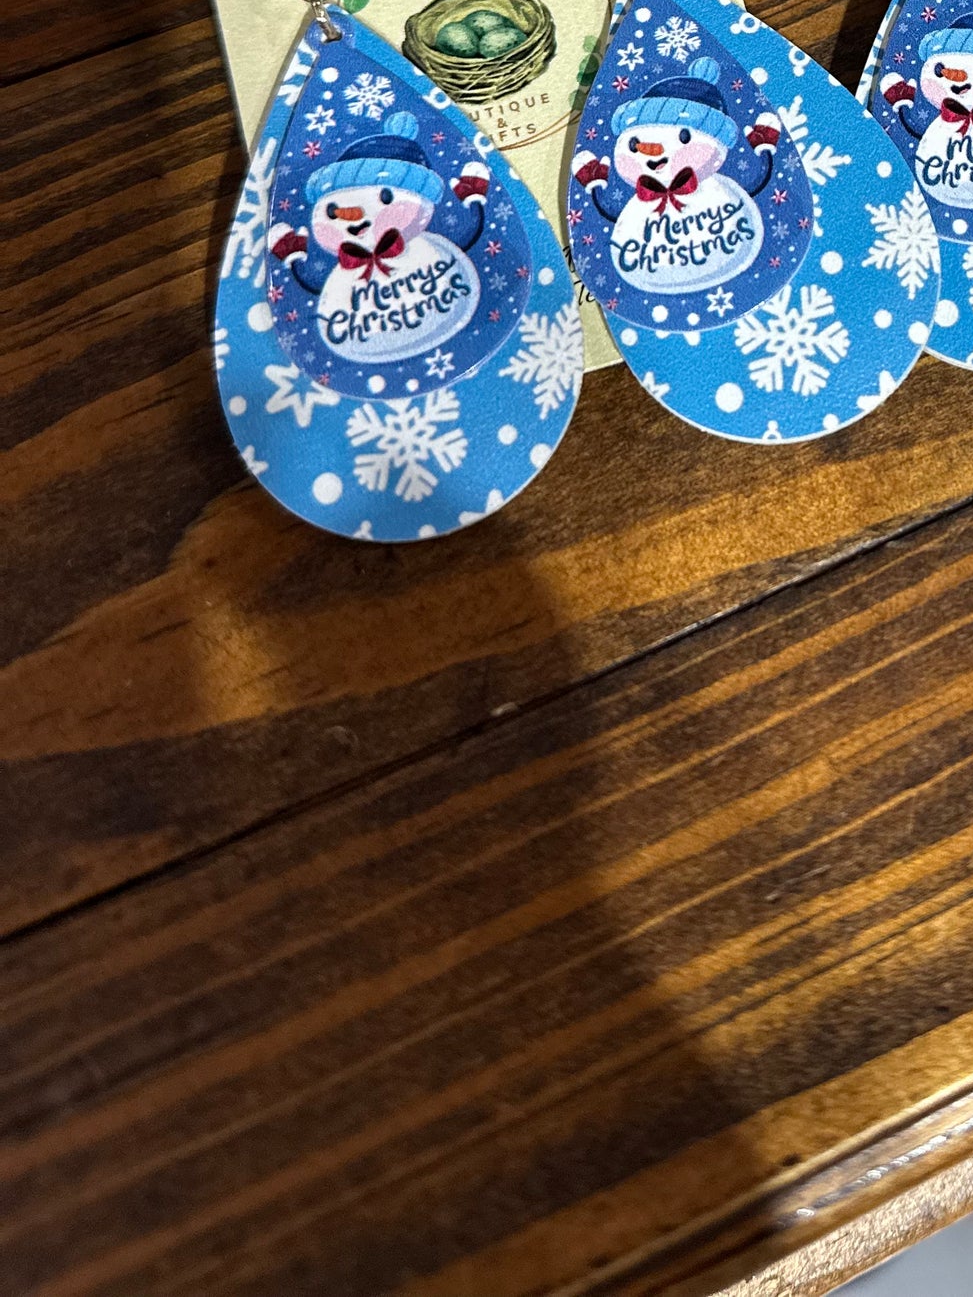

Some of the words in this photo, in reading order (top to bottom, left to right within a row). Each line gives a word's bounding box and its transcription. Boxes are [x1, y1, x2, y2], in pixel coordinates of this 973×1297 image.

[468, 92, 550, 122] UTIQUE
[497, 117, 508, 129] &
[489, 123, 537, 143] IFTS
[610, 216, 756, 273] Christmas
[643, 198, 745, 245] Merry
[350, 254, 457, 312] Merry
[315, 273, 472, 345] Christmas
